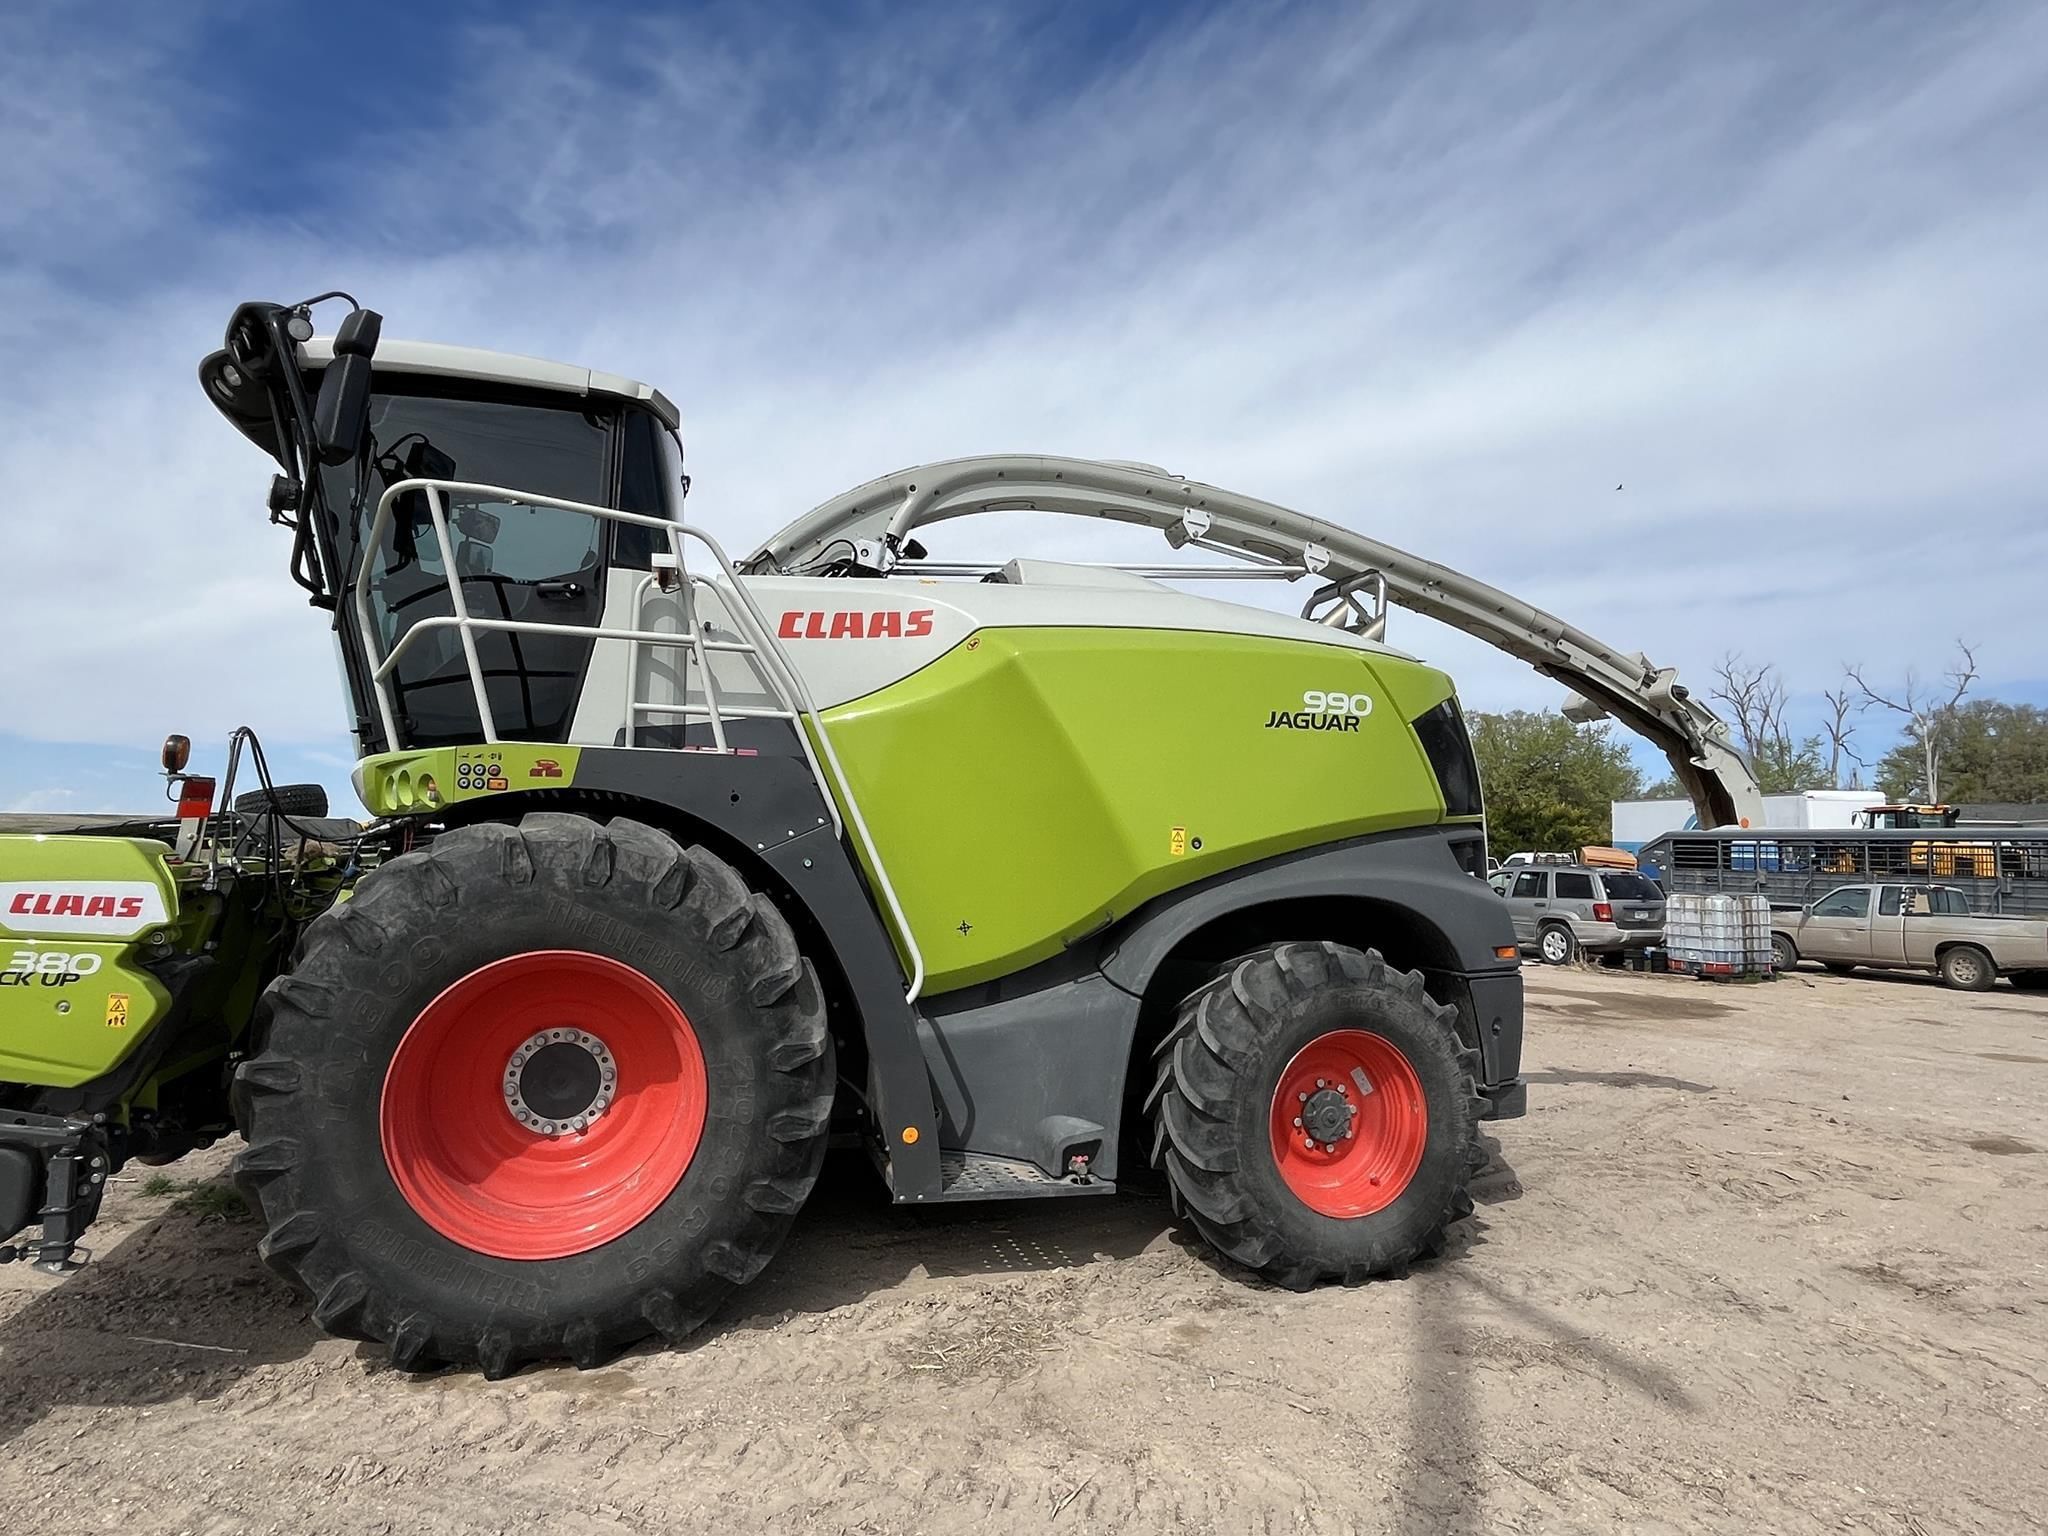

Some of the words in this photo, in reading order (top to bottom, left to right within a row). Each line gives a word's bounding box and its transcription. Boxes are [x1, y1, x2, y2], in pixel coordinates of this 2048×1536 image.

[778, 610, 934, 638] CLAAS
[1303, 691, 1373, 717] 990
[1264, 711, 1360, 732] JAGUAR
[9, 893, 144, 918] CLAAS
[5, 951, 102, 975] 380
[40, 972, 80, 987] UP
